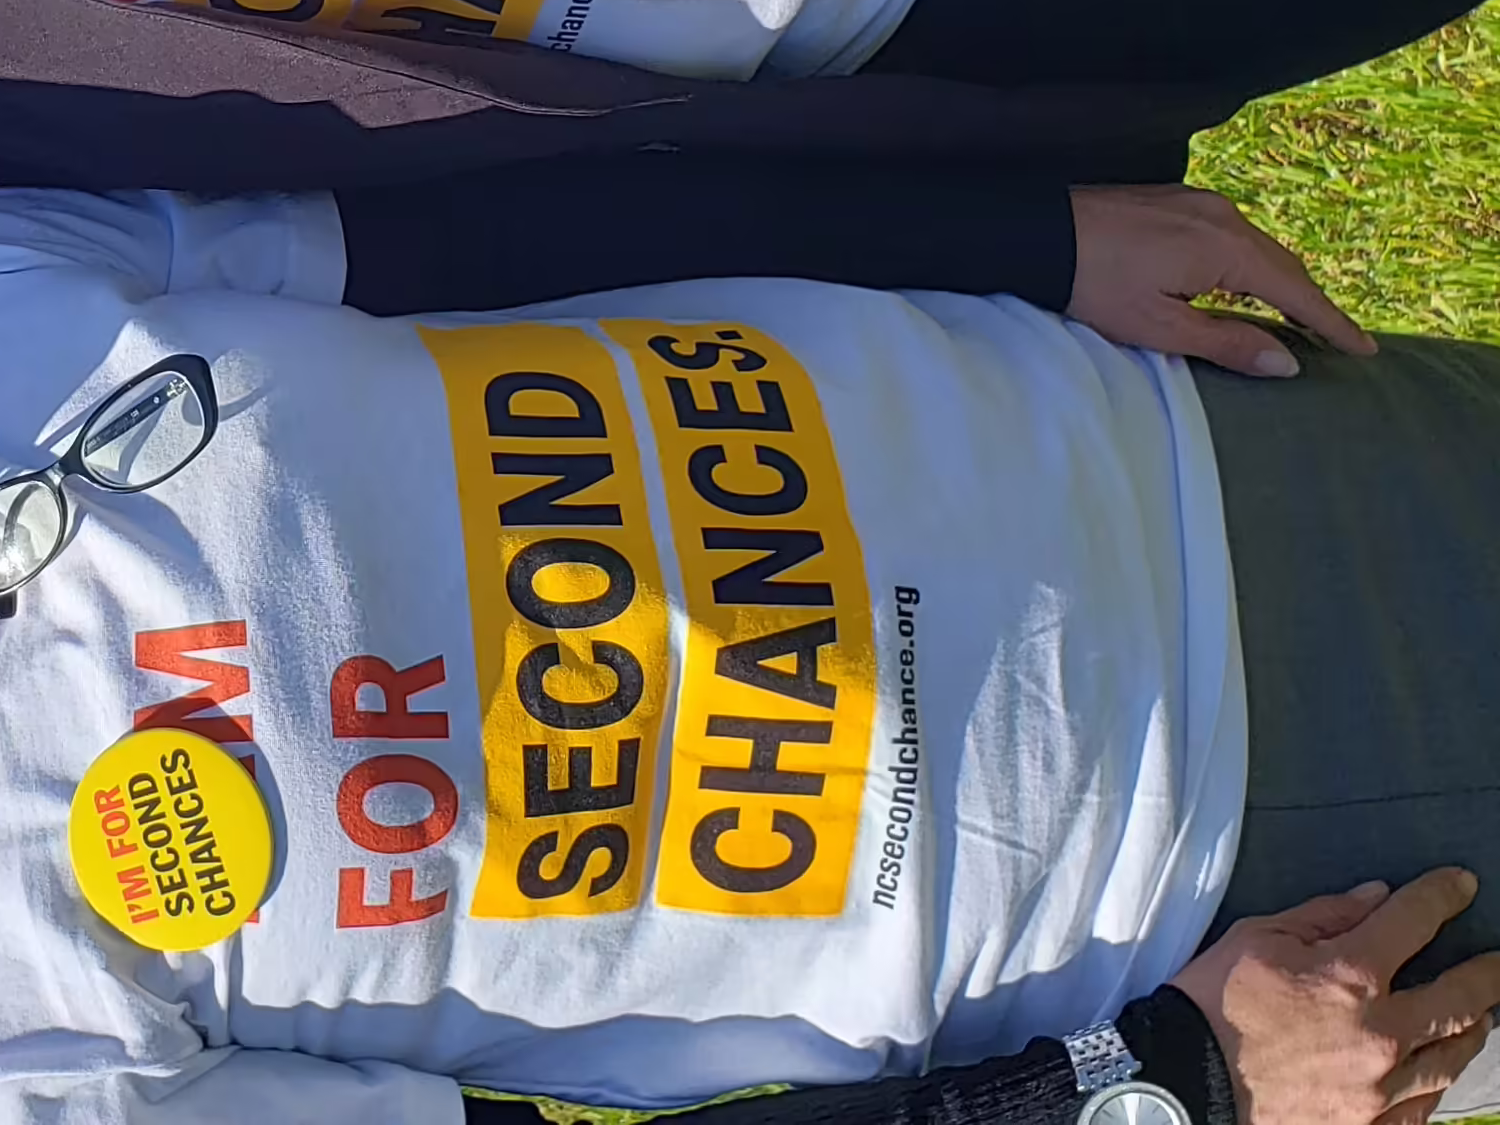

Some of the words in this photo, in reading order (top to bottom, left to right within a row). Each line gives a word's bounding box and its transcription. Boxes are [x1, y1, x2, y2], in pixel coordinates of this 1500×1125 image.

[483, 371, 643, 900] SECOND
[647, 329, 837, 893] CHANCES.
[134, 619, 257, 782] M
[872, 585, 921, 910] ncsecondchance.org
[94, 784, 139, 859] FOR
[128, 772, 195, 917] SECOND
[160, 748, 236, 916] CHANCES
[329, 653, 458, 929] FOR
[116, 865, 160, 924] I'M
